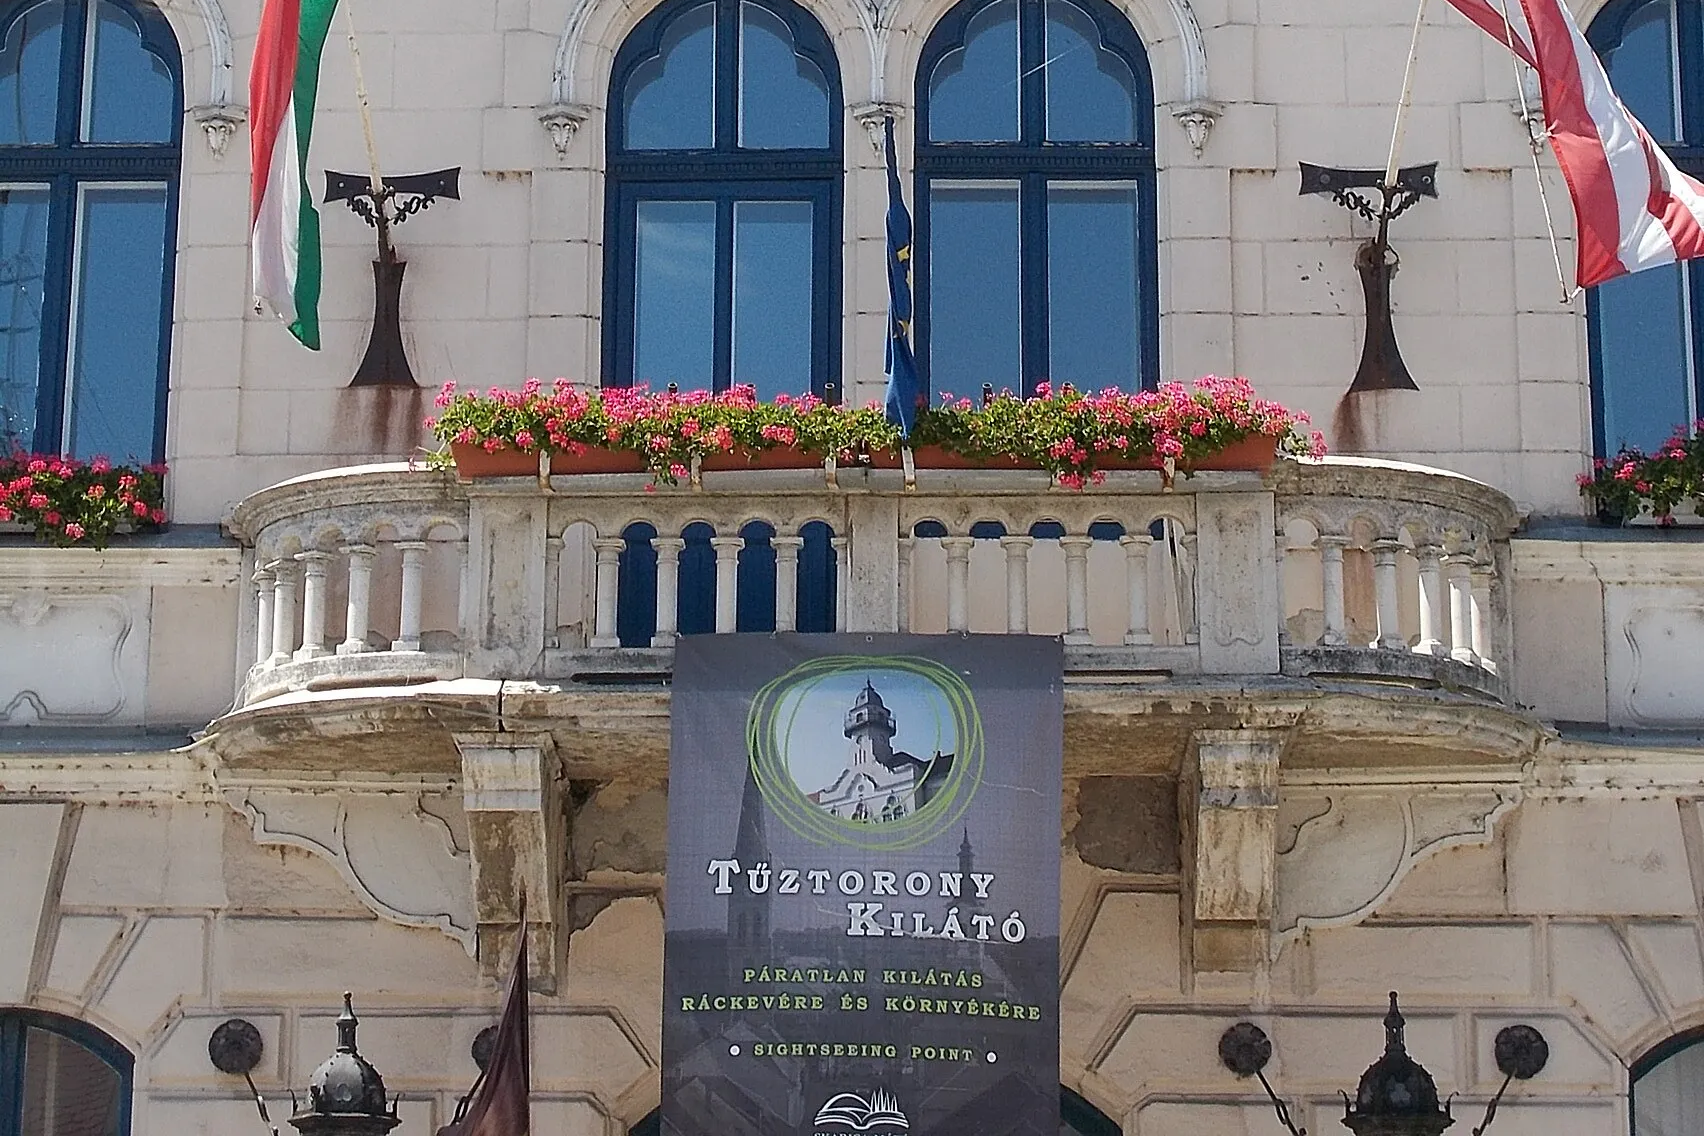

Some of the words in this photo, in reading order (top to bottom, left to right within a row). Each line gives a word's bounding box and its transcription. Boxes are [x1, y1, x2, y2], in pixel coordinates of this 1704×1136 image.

[743, 965, 866, 983] PÁRATLAN
[883, 968, 983, 988] KILÁTÁS
[681, 993, 824, 1011] RÁCKEVÉRE
[840, 993, 868, 1010] ÉS
[885, 995, 1041, 1021] KÖRNYÉKÉRE
[754, 1043, 897, 1058] SIGHTSEEING
[911, 1046, 973, 1062] POINT
